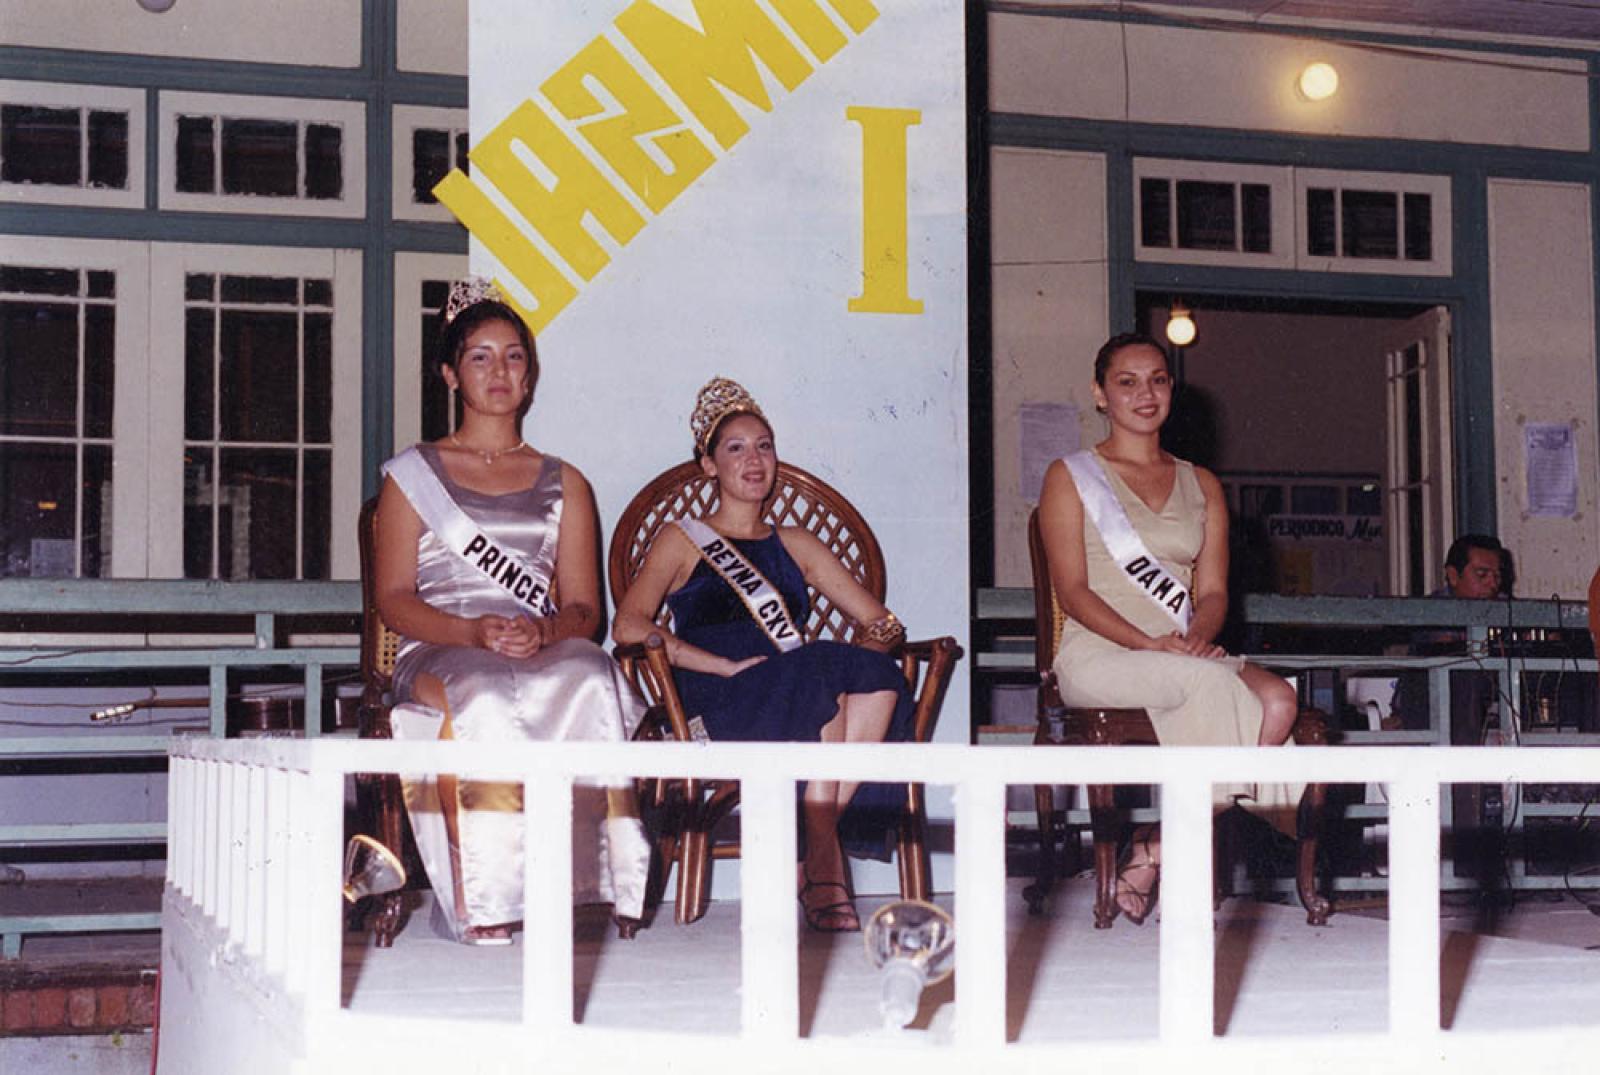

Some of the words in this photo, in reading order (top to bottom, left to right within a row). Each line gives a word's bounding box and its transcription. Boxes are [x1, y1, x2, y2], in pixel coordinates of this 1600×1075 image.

[845, 106, 923, 314] I
[463, 533, 556, 617] PRINCES
[702, 539, 763, 595] REYNA
[758, 600, 794, 639] CXV
[1125, 555, 1186, 614] DAMA
